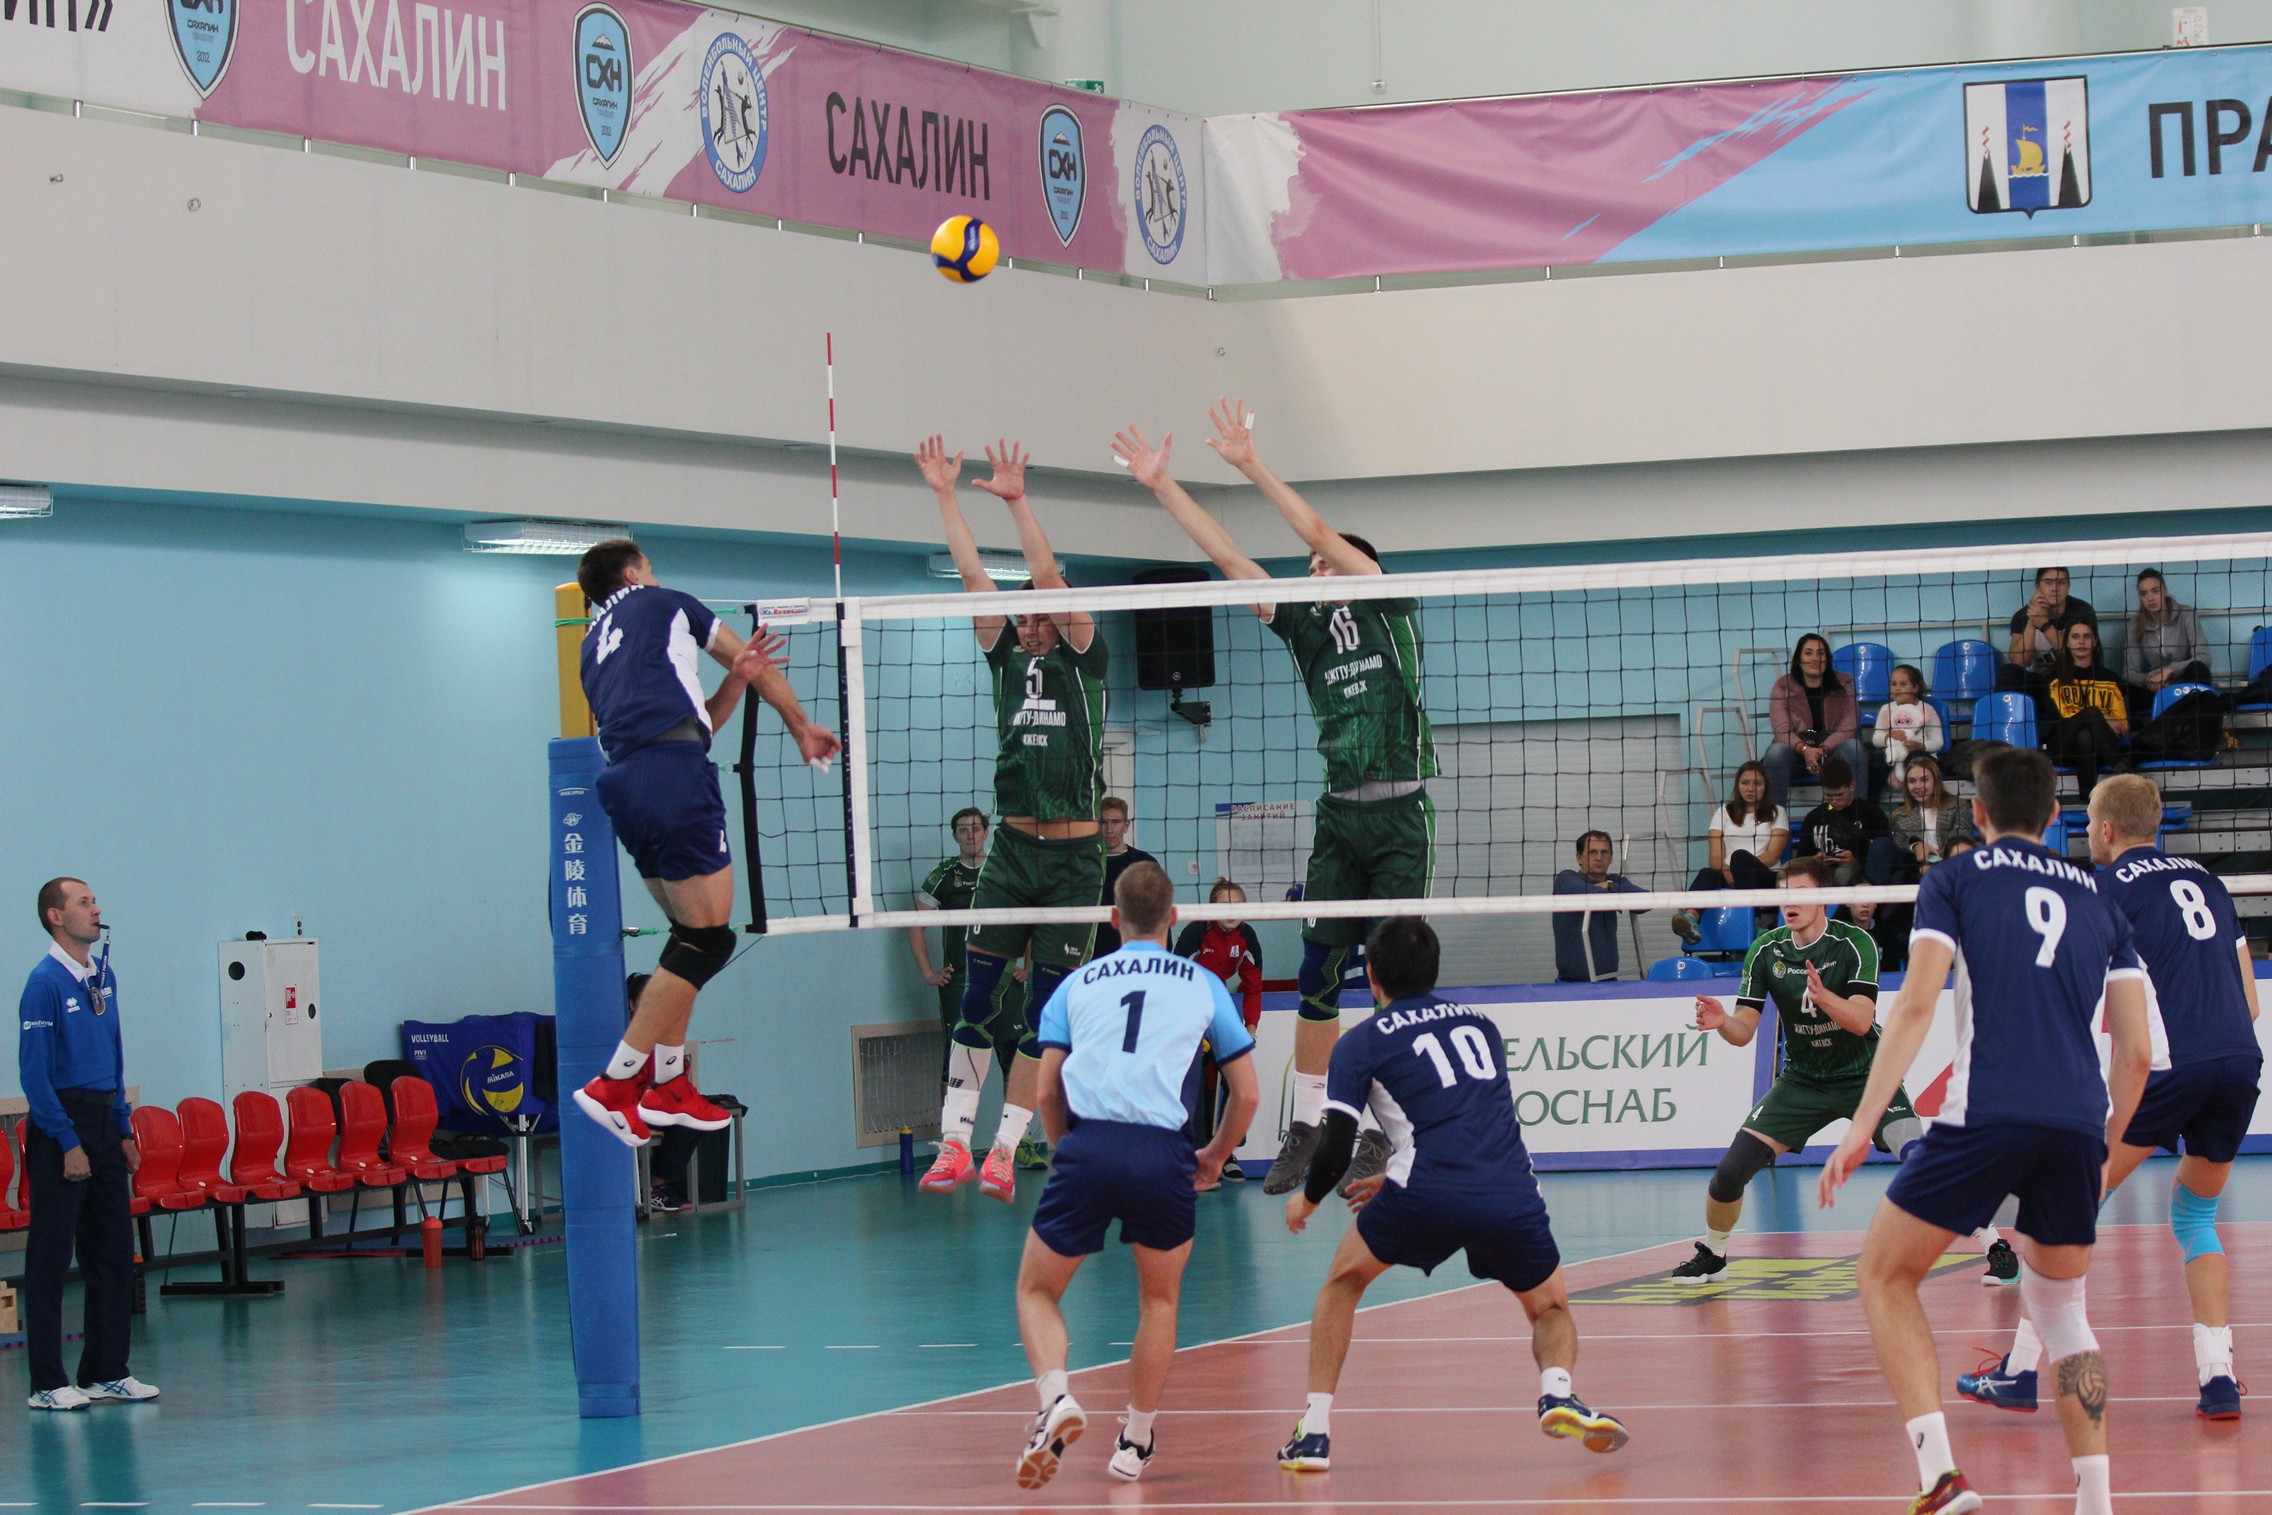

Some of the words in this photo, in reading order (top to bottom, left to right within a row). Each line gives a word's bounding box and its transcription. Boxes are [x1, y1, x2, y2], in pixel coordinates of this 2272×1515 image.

[187, 19, 219, 33] САХАЛИН
[197, 51, 211, 63] 2012
[287, 0, 507, 111] САХАЛИН
[702, 36, 753, 118] ВОЛЕЙБОЛЬНЫЙ
[752, 66, 768, 131] ЦЕНТР
[826, 91, 990, 201] САХАЛИН
[715, 159, 757, 191] САХАЛИН
[1147, 236, 1178, 263] САХАЛИН
[597, 612, 624, 665] 4
[1330, 605, 1361, 655] 16
[1026, 656, 1044, 699] 5
[1231, 802, 1295, 812] РАСПИСАНИЕ
[1241, 811, 1286, 821] ЗАНЯТИЙ
[564, 833, 588, 935] 金陵体育
[1973, 847, 2099, 894] САХАЛИН
[2115, 856, 2210, 884] САХАЛИН
[2025, 886, 2067, 968] 9
[2169, 879, 2217, 941] 8
[1083, 957, 1195, 985] САХАЛИН
[1801, 984, 1817, 1018] 4
[411, 1034, 449, 1043] VOLLEYBALL
[1120, 990, 1147, 1054] 1
[1411, 1024, 1498, 1089] 10
[1514, 1087, 1677, 1127] ОСНАБ
[1752, 1105, 1764, 1121] 4
